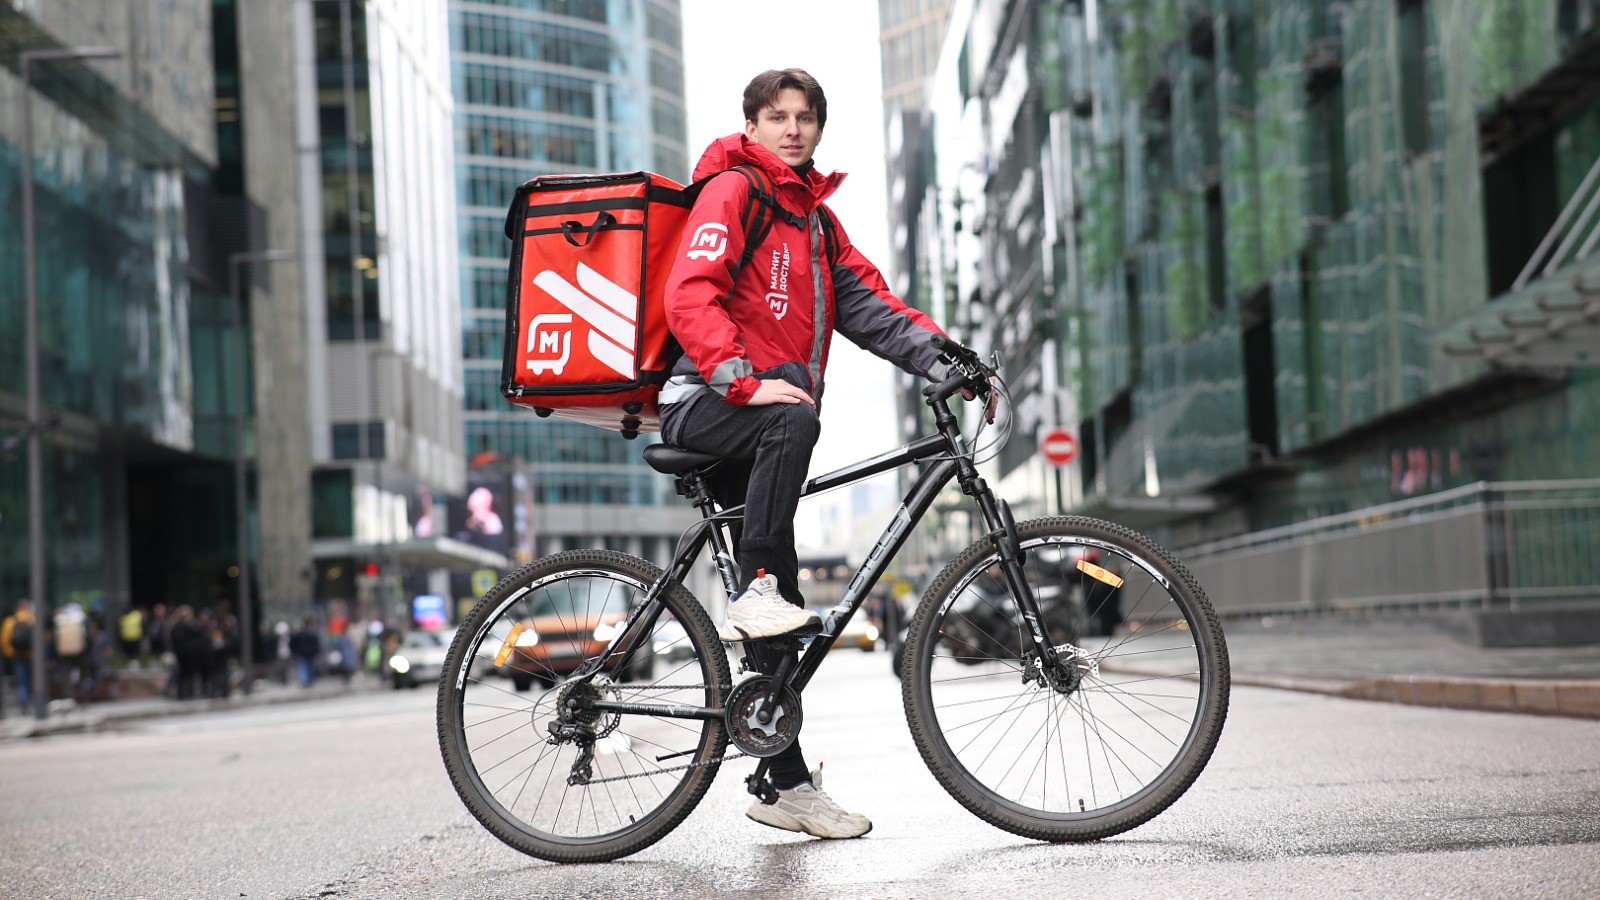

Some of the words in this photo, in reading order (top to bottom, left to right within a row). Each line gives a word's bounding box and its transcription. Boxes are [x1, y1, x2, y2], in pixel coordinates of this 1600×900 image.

[770, 249, 781, 290] МАГНИТ
[779, 243, 790, 292] ДОСТАВКА
[849, 515, 904, 594] STELS
